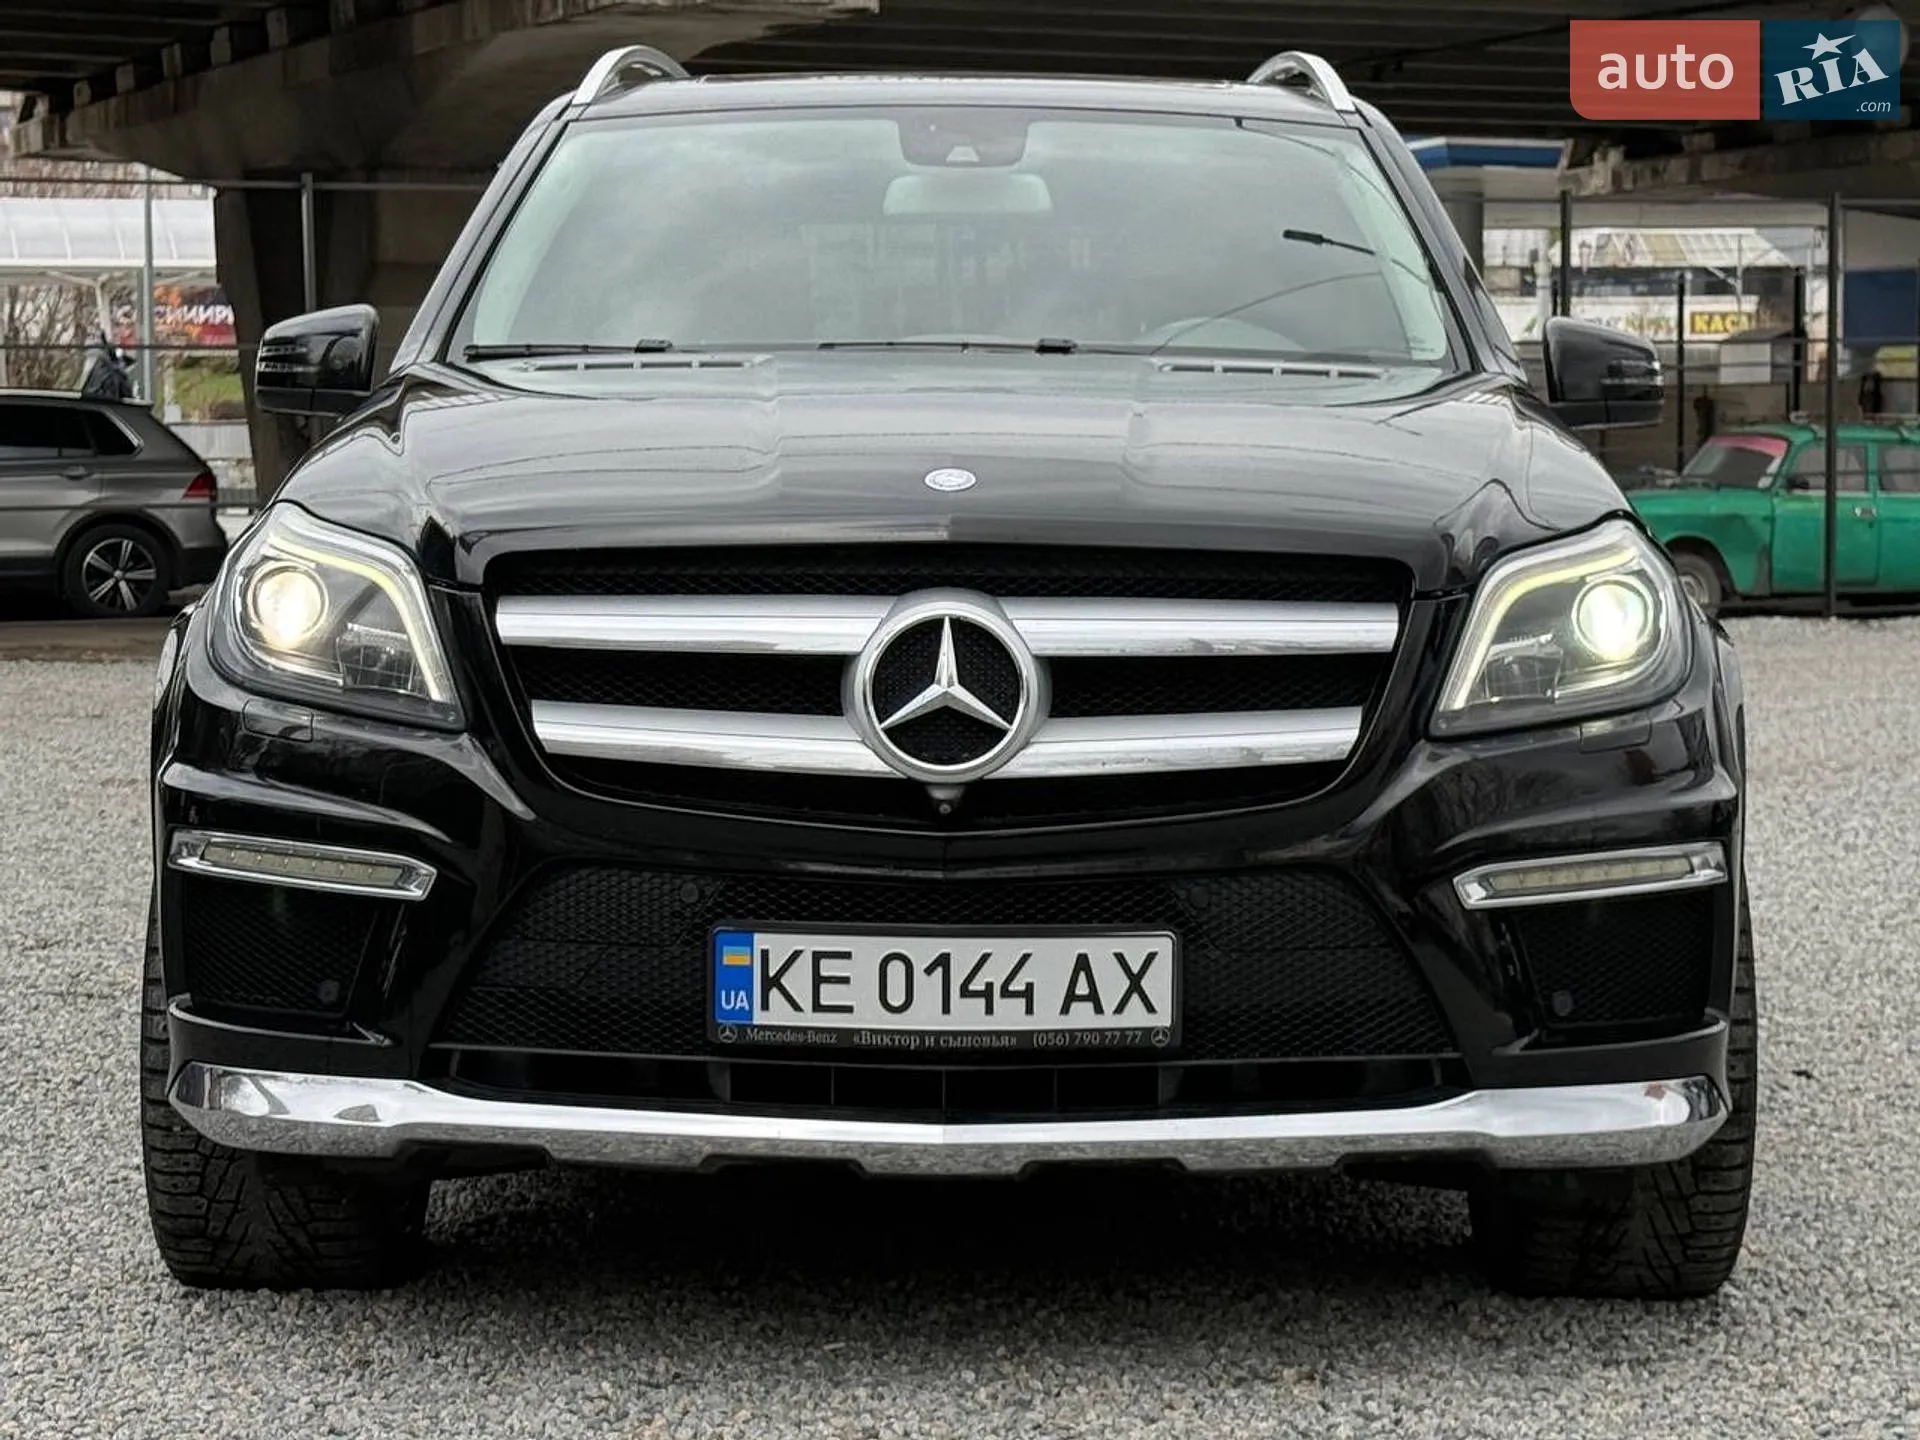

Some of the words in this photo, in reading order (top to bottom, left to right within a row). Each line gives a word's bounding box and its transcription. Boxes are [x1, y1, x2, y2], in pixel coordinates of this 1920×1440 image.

[760, 948, 854, 1014] KE
[878, 951, 1035, 1016] 0144
[1059, 951, 1159, 1016] AX
[721, 989, 750, 1010] UA
[746, 1029, 838, 1045] Mercedes-Benz
[925, 1034, 935, 1048] и
[1033, 1032, 1070, 1048] (056)
[1074, 1032, 1100, 1046] 790
[1105, 1031, 1121, 1045] 77
[1125, 1030, 1143, 1045] 77
